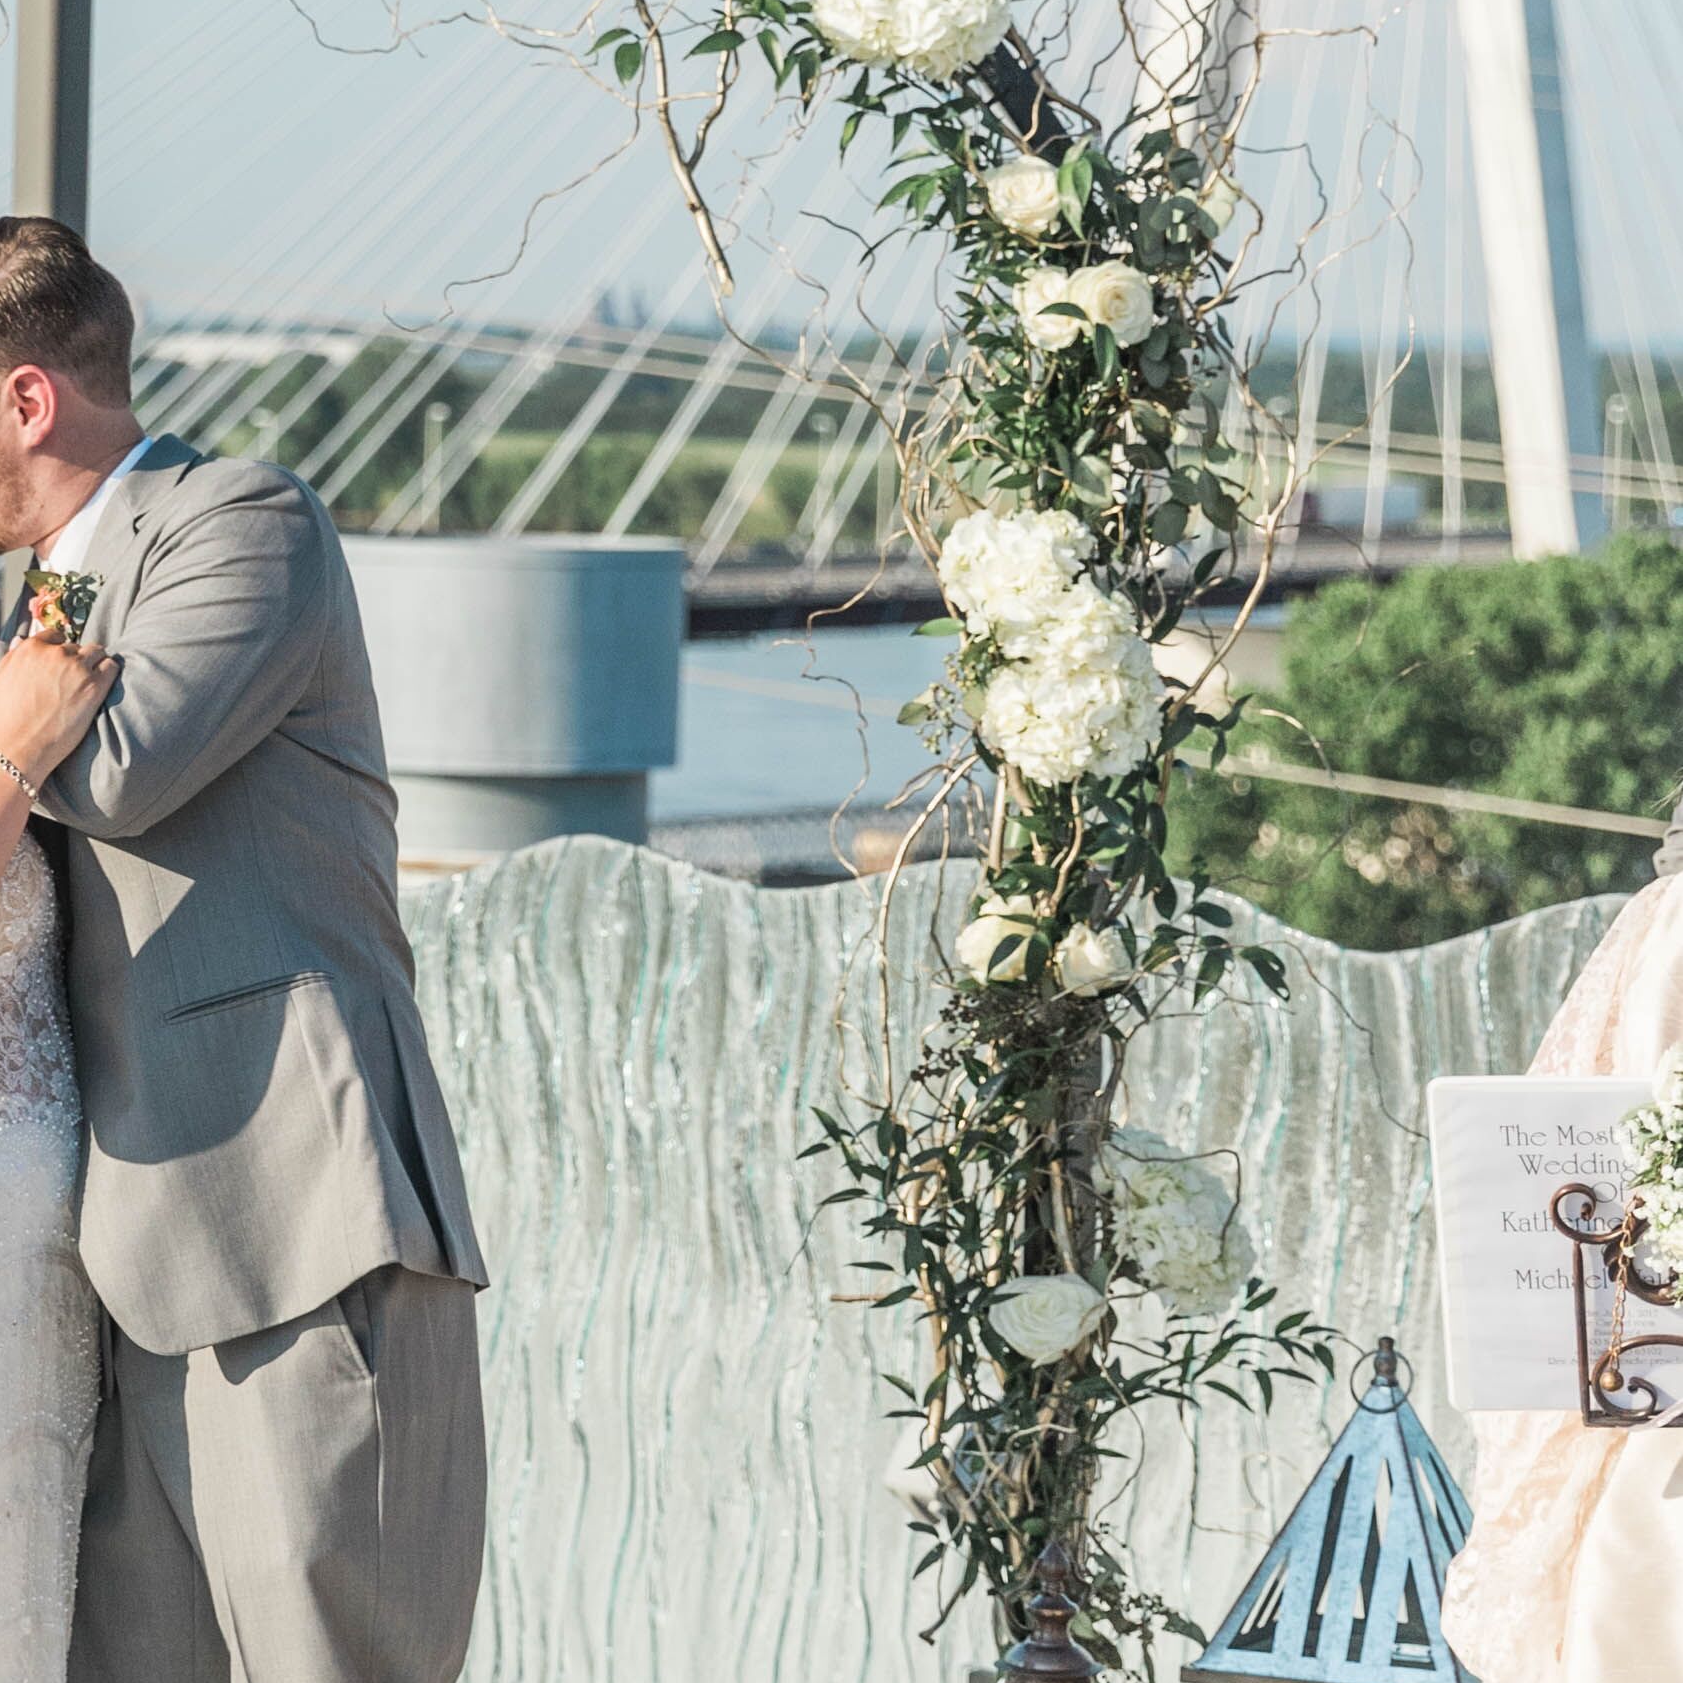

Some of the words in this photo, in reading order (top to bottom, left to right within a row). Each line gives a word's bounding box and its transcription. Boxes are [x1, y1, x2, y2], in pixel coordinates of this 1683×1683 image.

[1500, 1124, 1547, 1147] The
[1557, 1124, 1619, 1146] Most
[1518, 1152, 1637, 1182] Wedding
[1515, 1267, 1609, 1291] Michel
